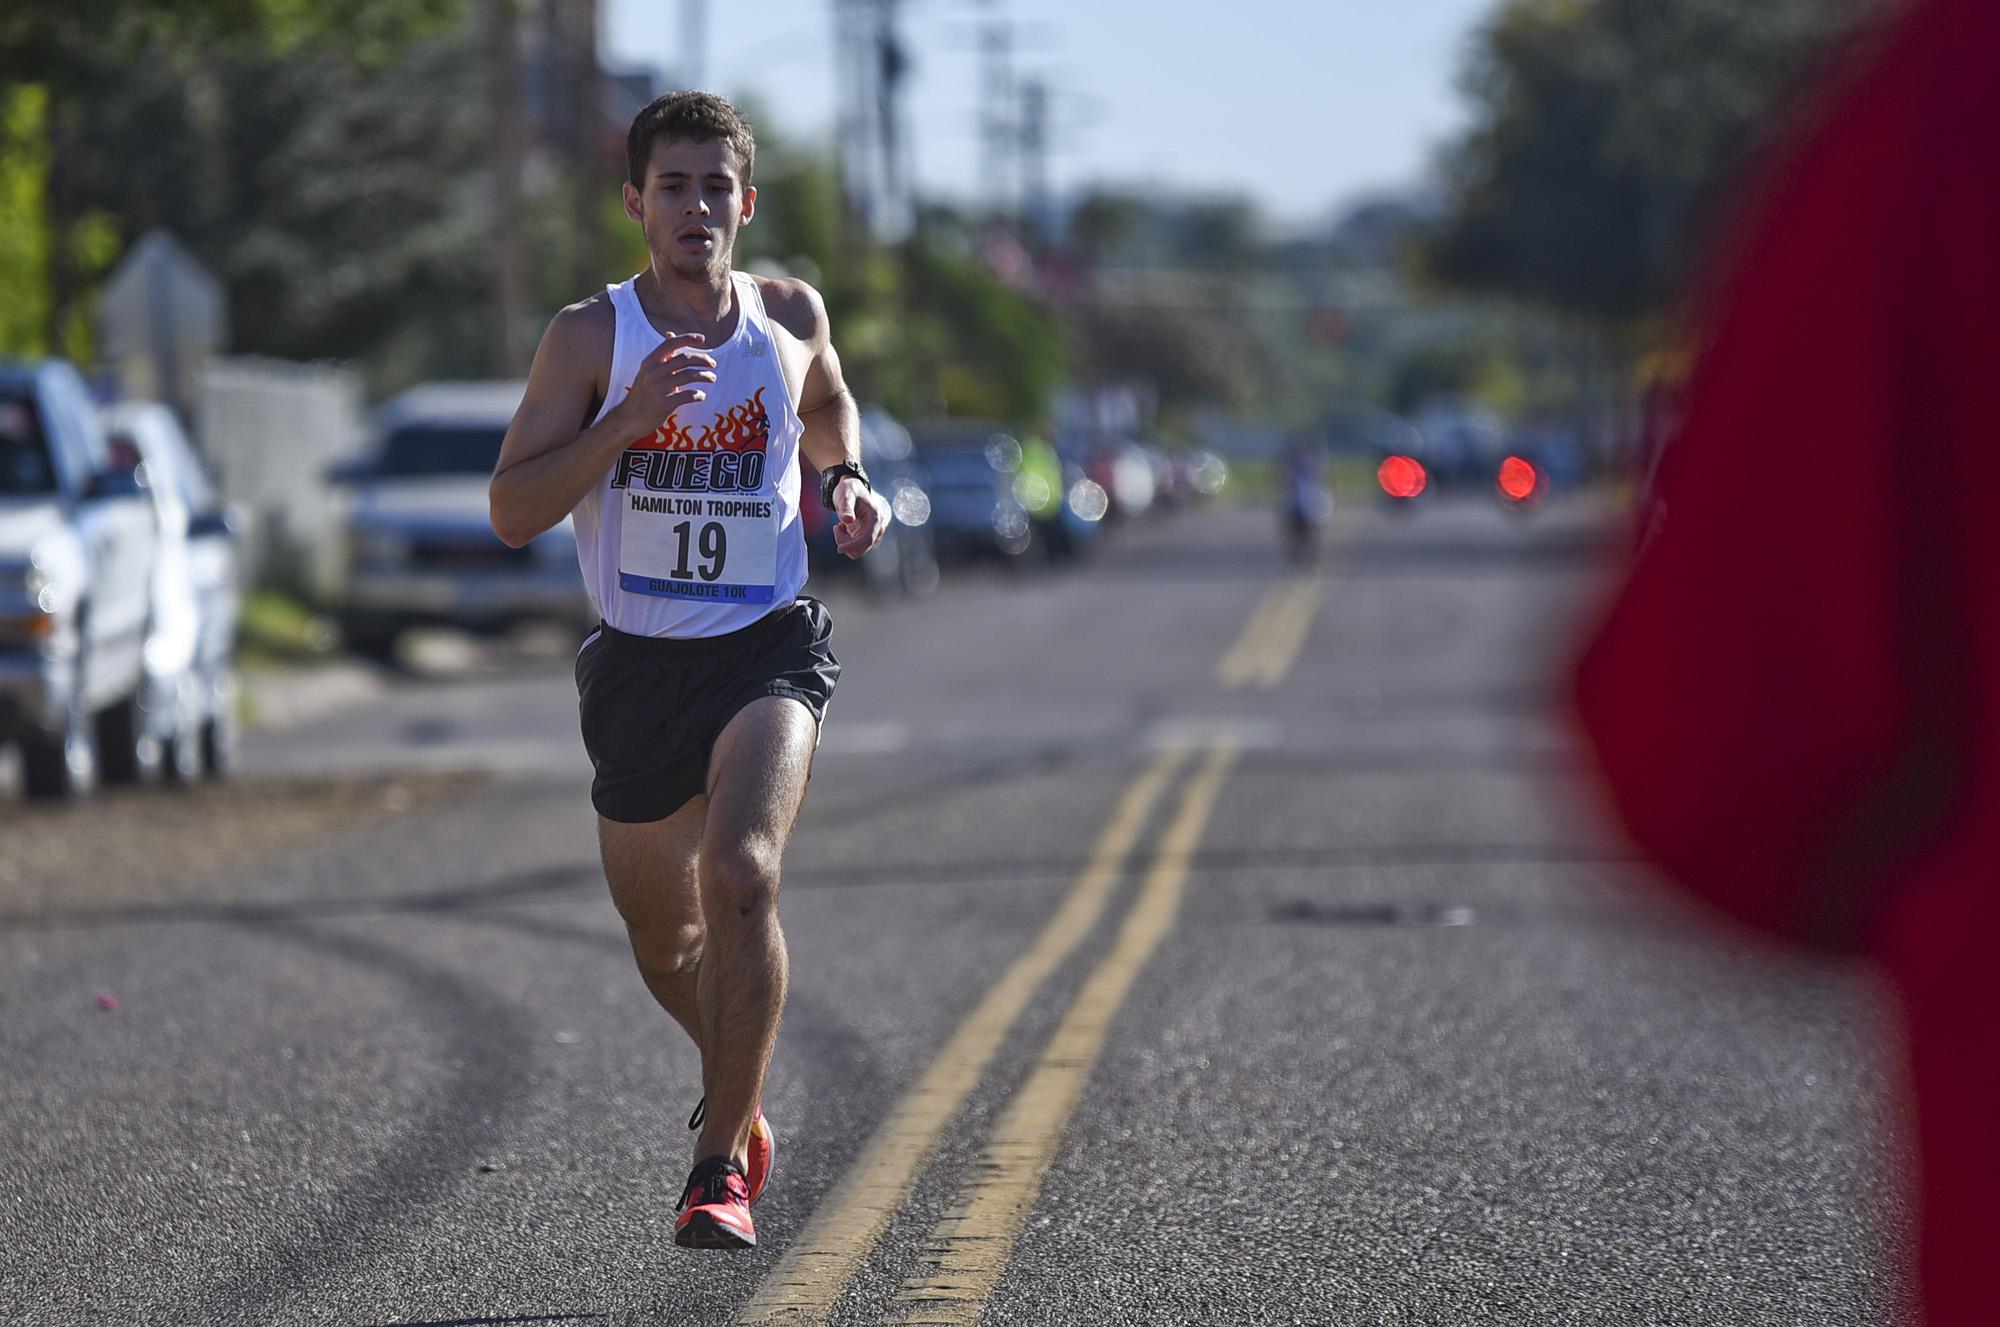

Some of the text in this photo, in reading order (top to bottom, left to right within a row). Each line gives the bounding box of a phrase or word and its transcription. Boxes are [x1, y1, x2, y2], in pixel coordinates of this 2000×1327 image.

[610, 449, 767, 494] FUEGO
[631, 495, 771, 518] HAMILTON TROPHIES
[670, 520, 727, 582] 19
[649, 580, 747, 598] GUAJOLOTE 10K
